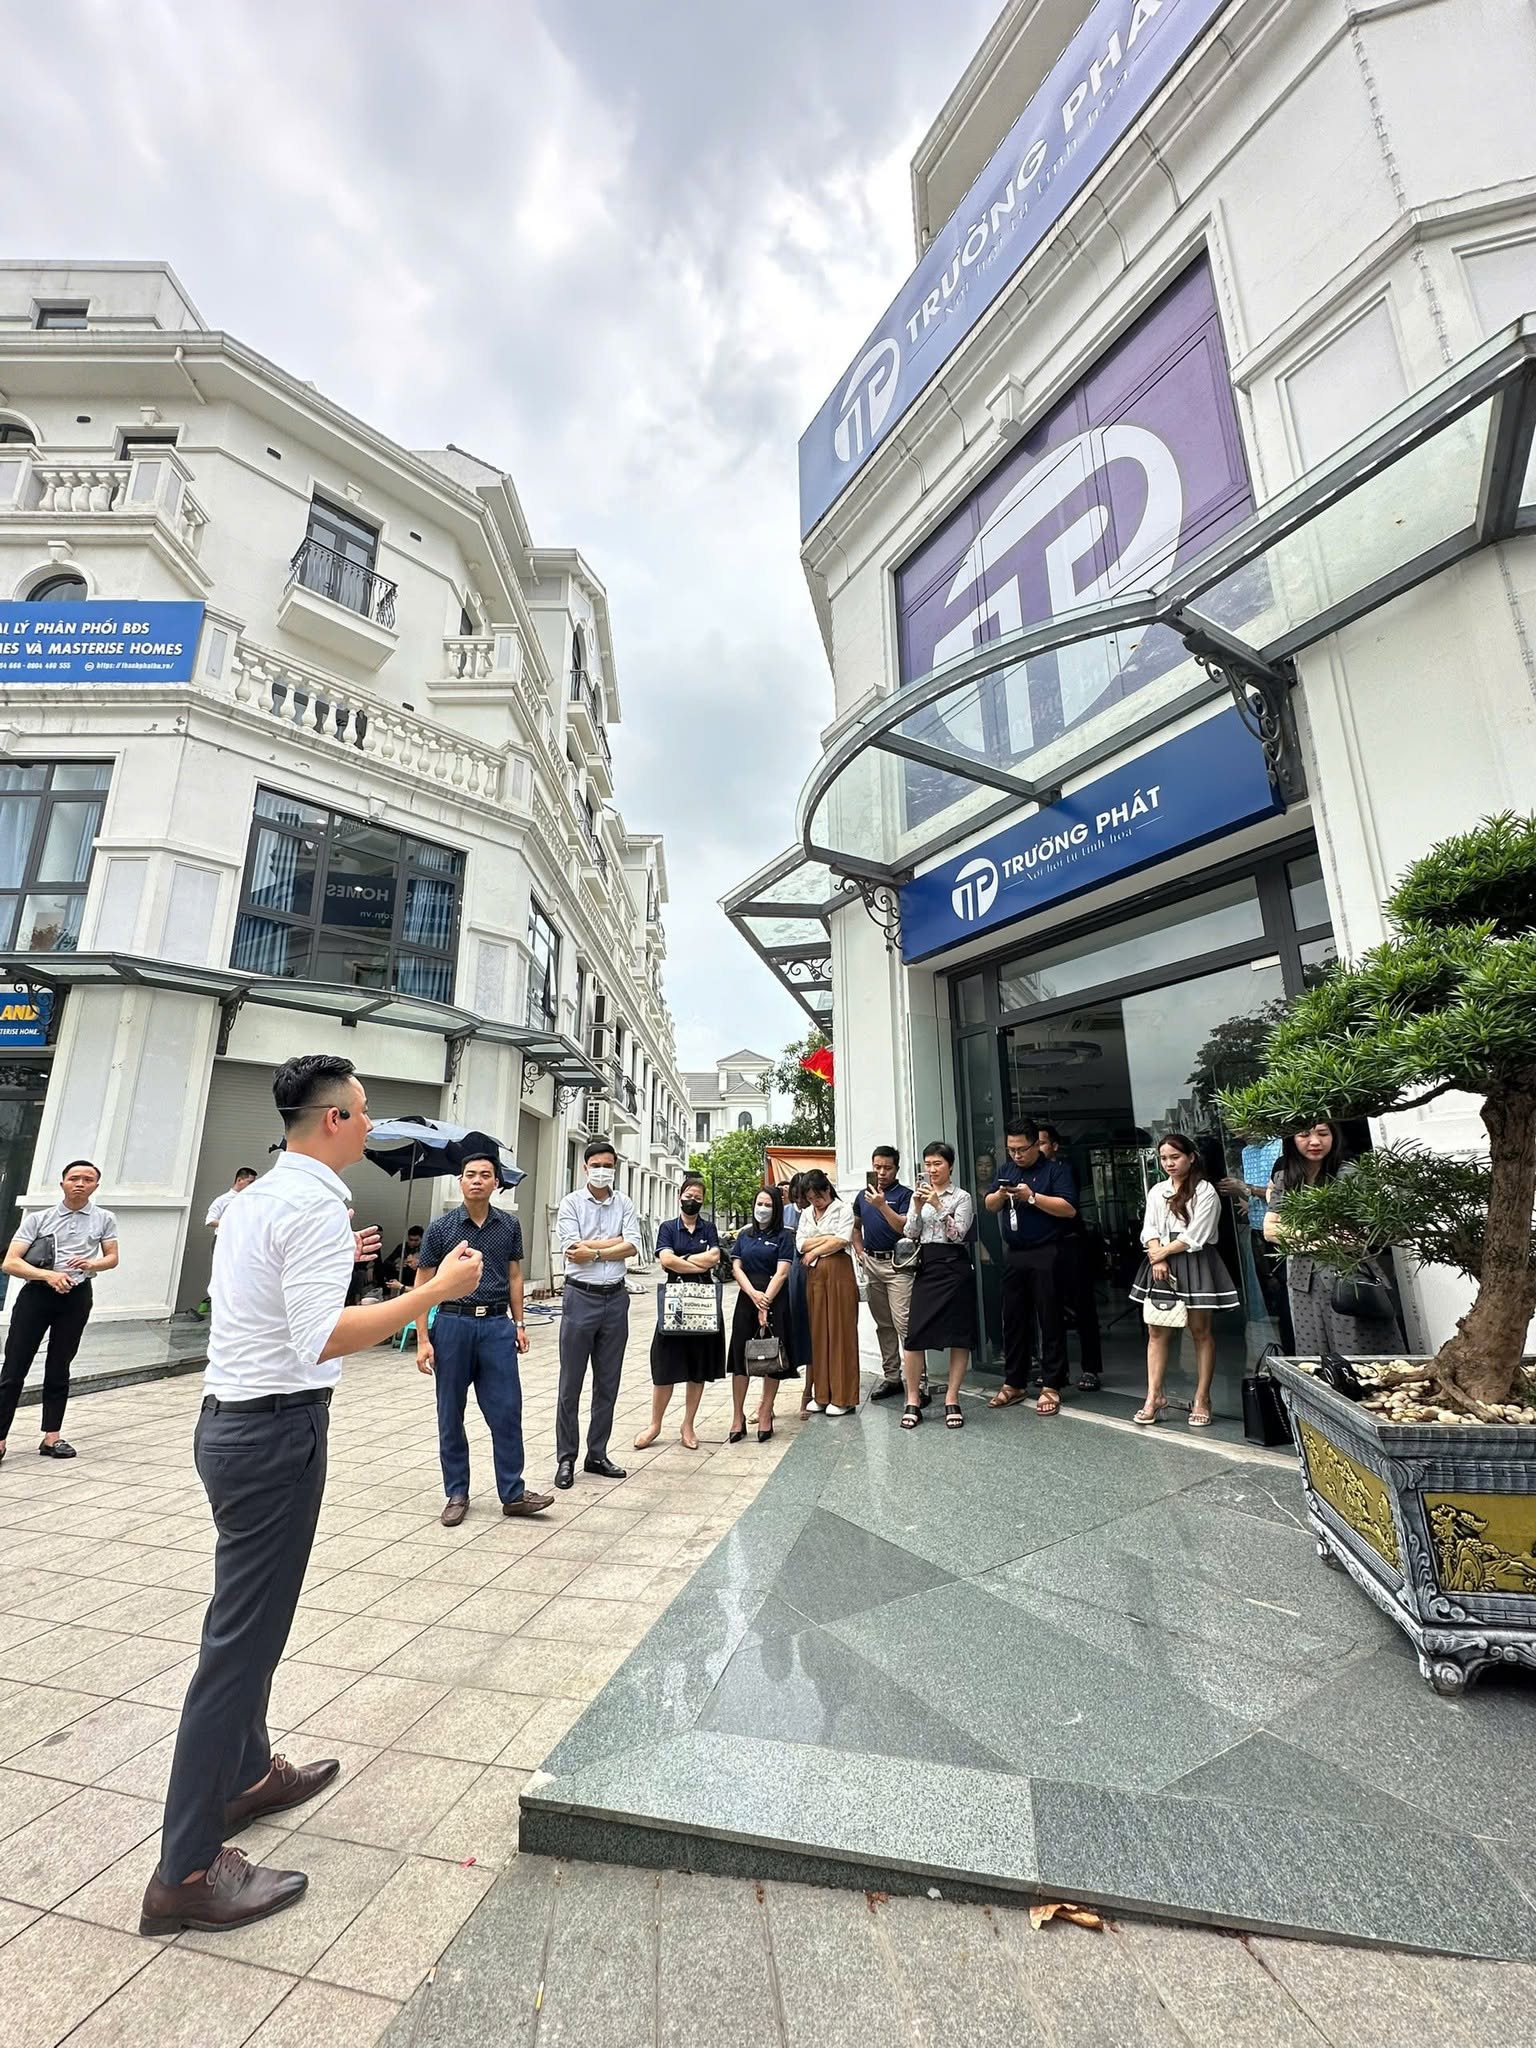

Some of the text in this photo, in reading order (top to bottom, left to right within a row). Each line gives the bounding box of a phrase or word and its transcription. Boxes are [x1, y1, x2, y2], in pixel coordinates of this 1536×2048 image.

[905, 138, 1048, 345] TRƯỜNG
[13, 620, 31, 634] LÝ
[34, 620, 77, 634] PHÂN
[81, 618, 118, 634] PHỐI
[122, 622, 150, 634] BĐS
[0, 640, 183, 656] ES VÀ MASTERISE HOMES
[1002, 785, 1161, 879] TRƯỜNG PHÁT
[0, 1004, 40, 1020] AND
